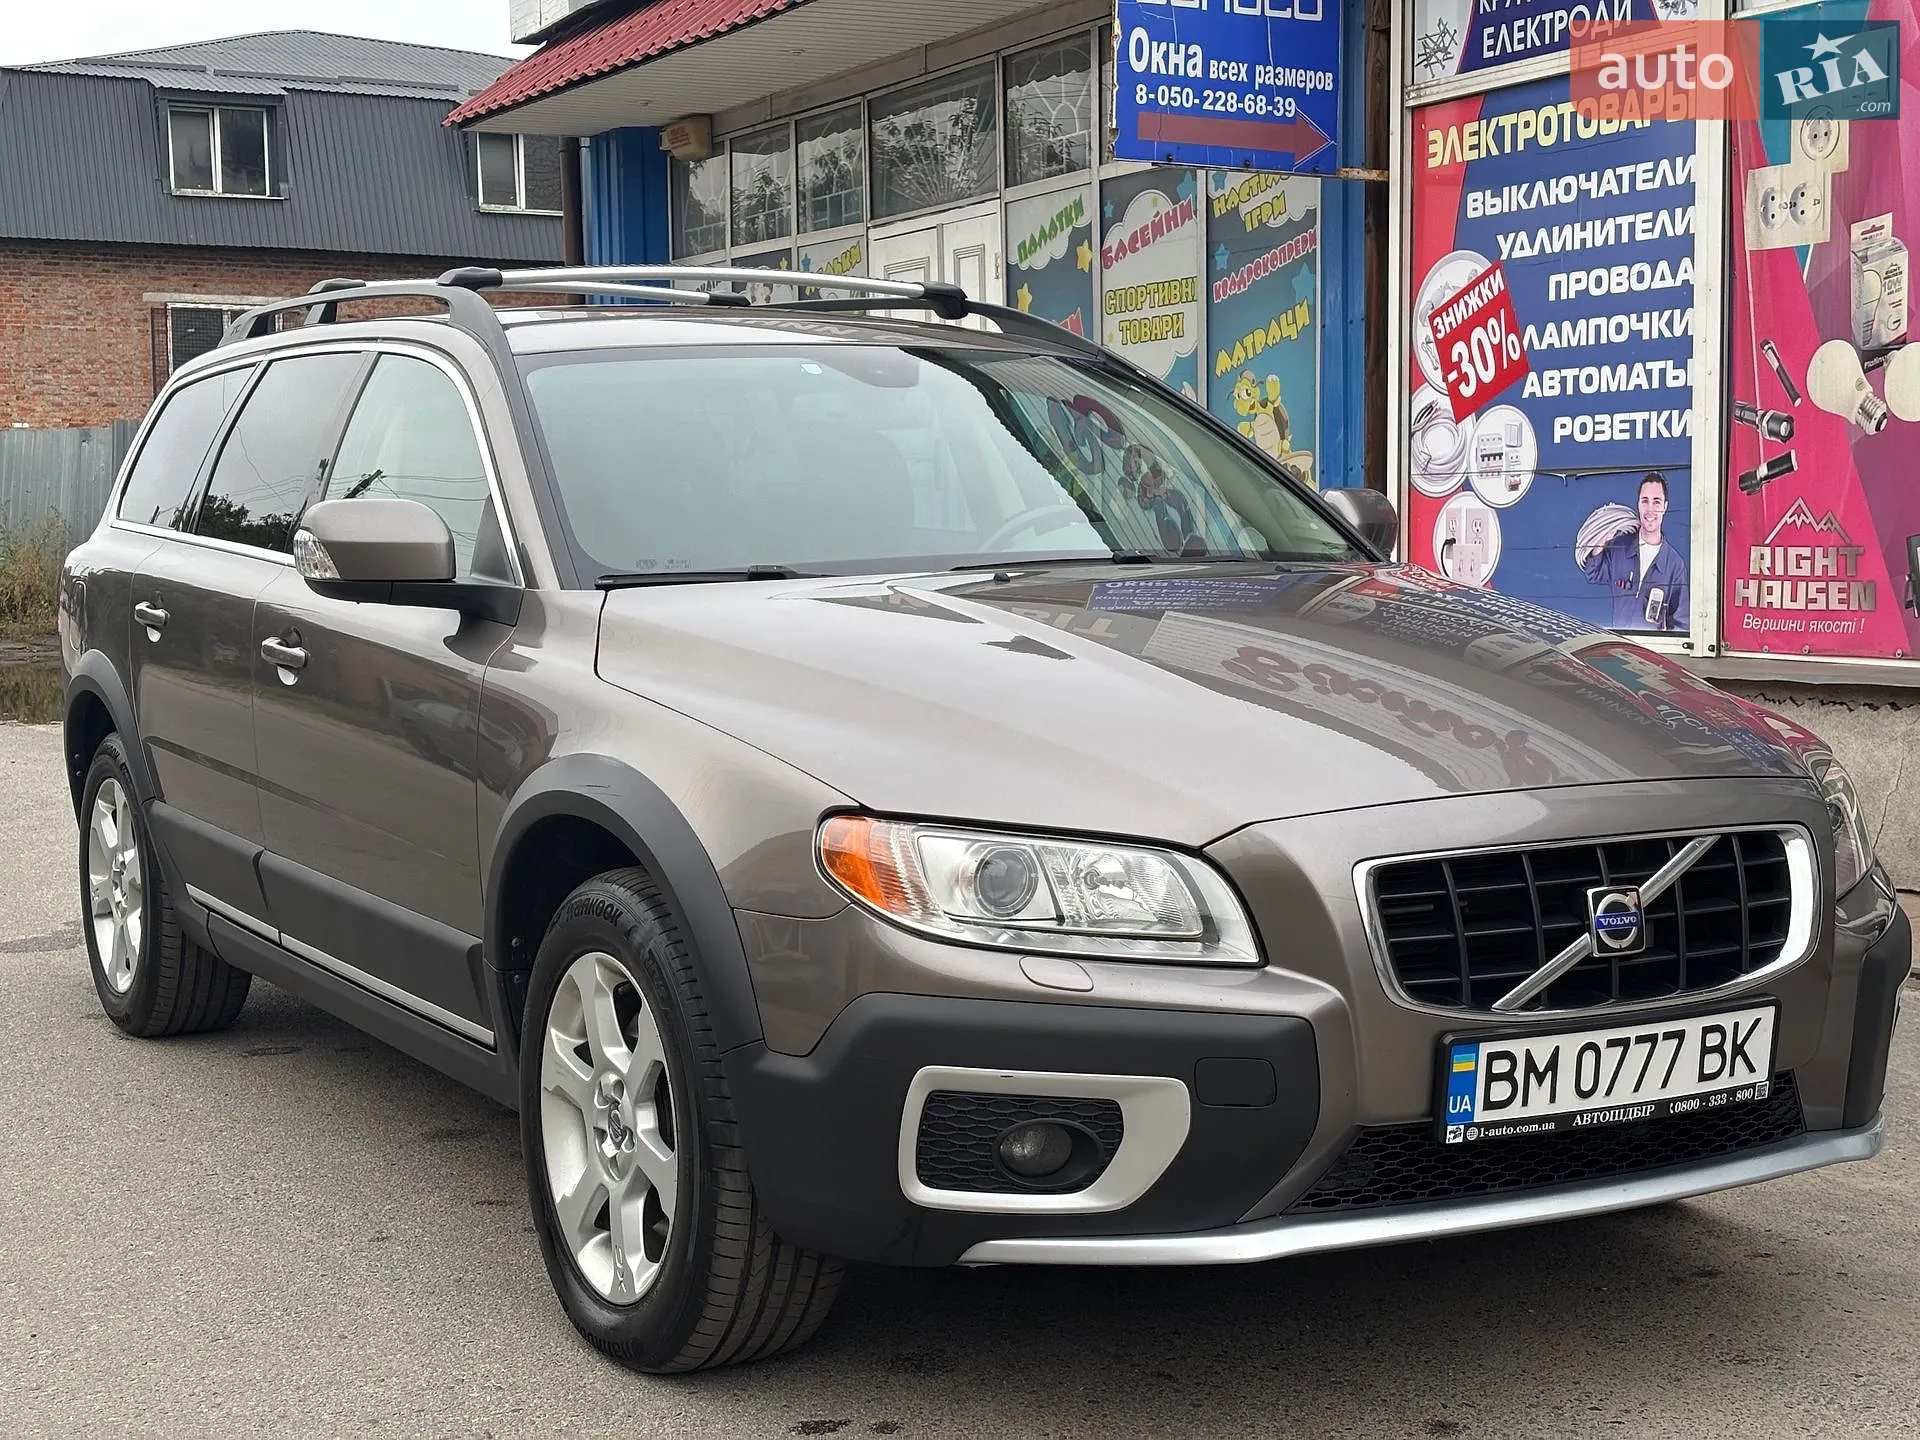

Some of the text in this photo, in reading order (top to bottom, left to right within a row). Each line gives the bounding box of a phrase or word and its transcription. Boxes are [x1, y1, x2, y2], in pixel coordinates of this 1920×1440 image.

[1482, 0, 1632, 59] ЕЛЕКТРОДИ
[1128, 26, 1333, 95] Окна всех размеров
[1427, 77, 1695, 169] ЭЛЕКТРОТОВАРЫ
[1466, 154, 1696, 219] ВЫКЛЮЧАТЕЛИ
[1016, 193, 1085, 264] ПАЛАТКИ
[1244, 190, 1287, 233] ІГРИ
[1496, 205, 1696, 261] УДЛИНИТЕЛИ
[1101, 197, 1196, 272] БАСЕЙНИ
[1549, 257, 1695, 301] ПРОВОДА
[1432, 268, 1505, 340] ЗНИЖКИ
[1118, 312, 1185, 346] ТОВАРИ
[1215, 296, 1311, 378] МАТРАЦИ
[1523, 308, 1694, 351] ЛАМПОЧКИ
[1446, 308, 1521, 399] -30%
[1521, 359, 1694, 399] АВТОМАТЫ
[1553, 409, 1693, 443] РОЗЕТКИ
[1749, 546, 1864, 577] RIGHT
[1734, 578, 1877, 612] HAUSEN
[1743, 613, 1806, 634] Вершини
[1808, 617, 1857, 634] якості
[1598, 915, 1637, 926] VOLVO
[1481, 1017, 1762, 1111] BM 0777 BK
[1448, 1094, 1472, 1114] UA
[1572, 1104, 1655, 1127] АВТОПІДБІР
[1674, 1099, 1700, 1113] 0800
[1708, 1093, 1728, 1107] 333
[1736, 1088, 1754, 1101] 800
[1478, 1121, 1556, 1138] 1-auto.com.ua
